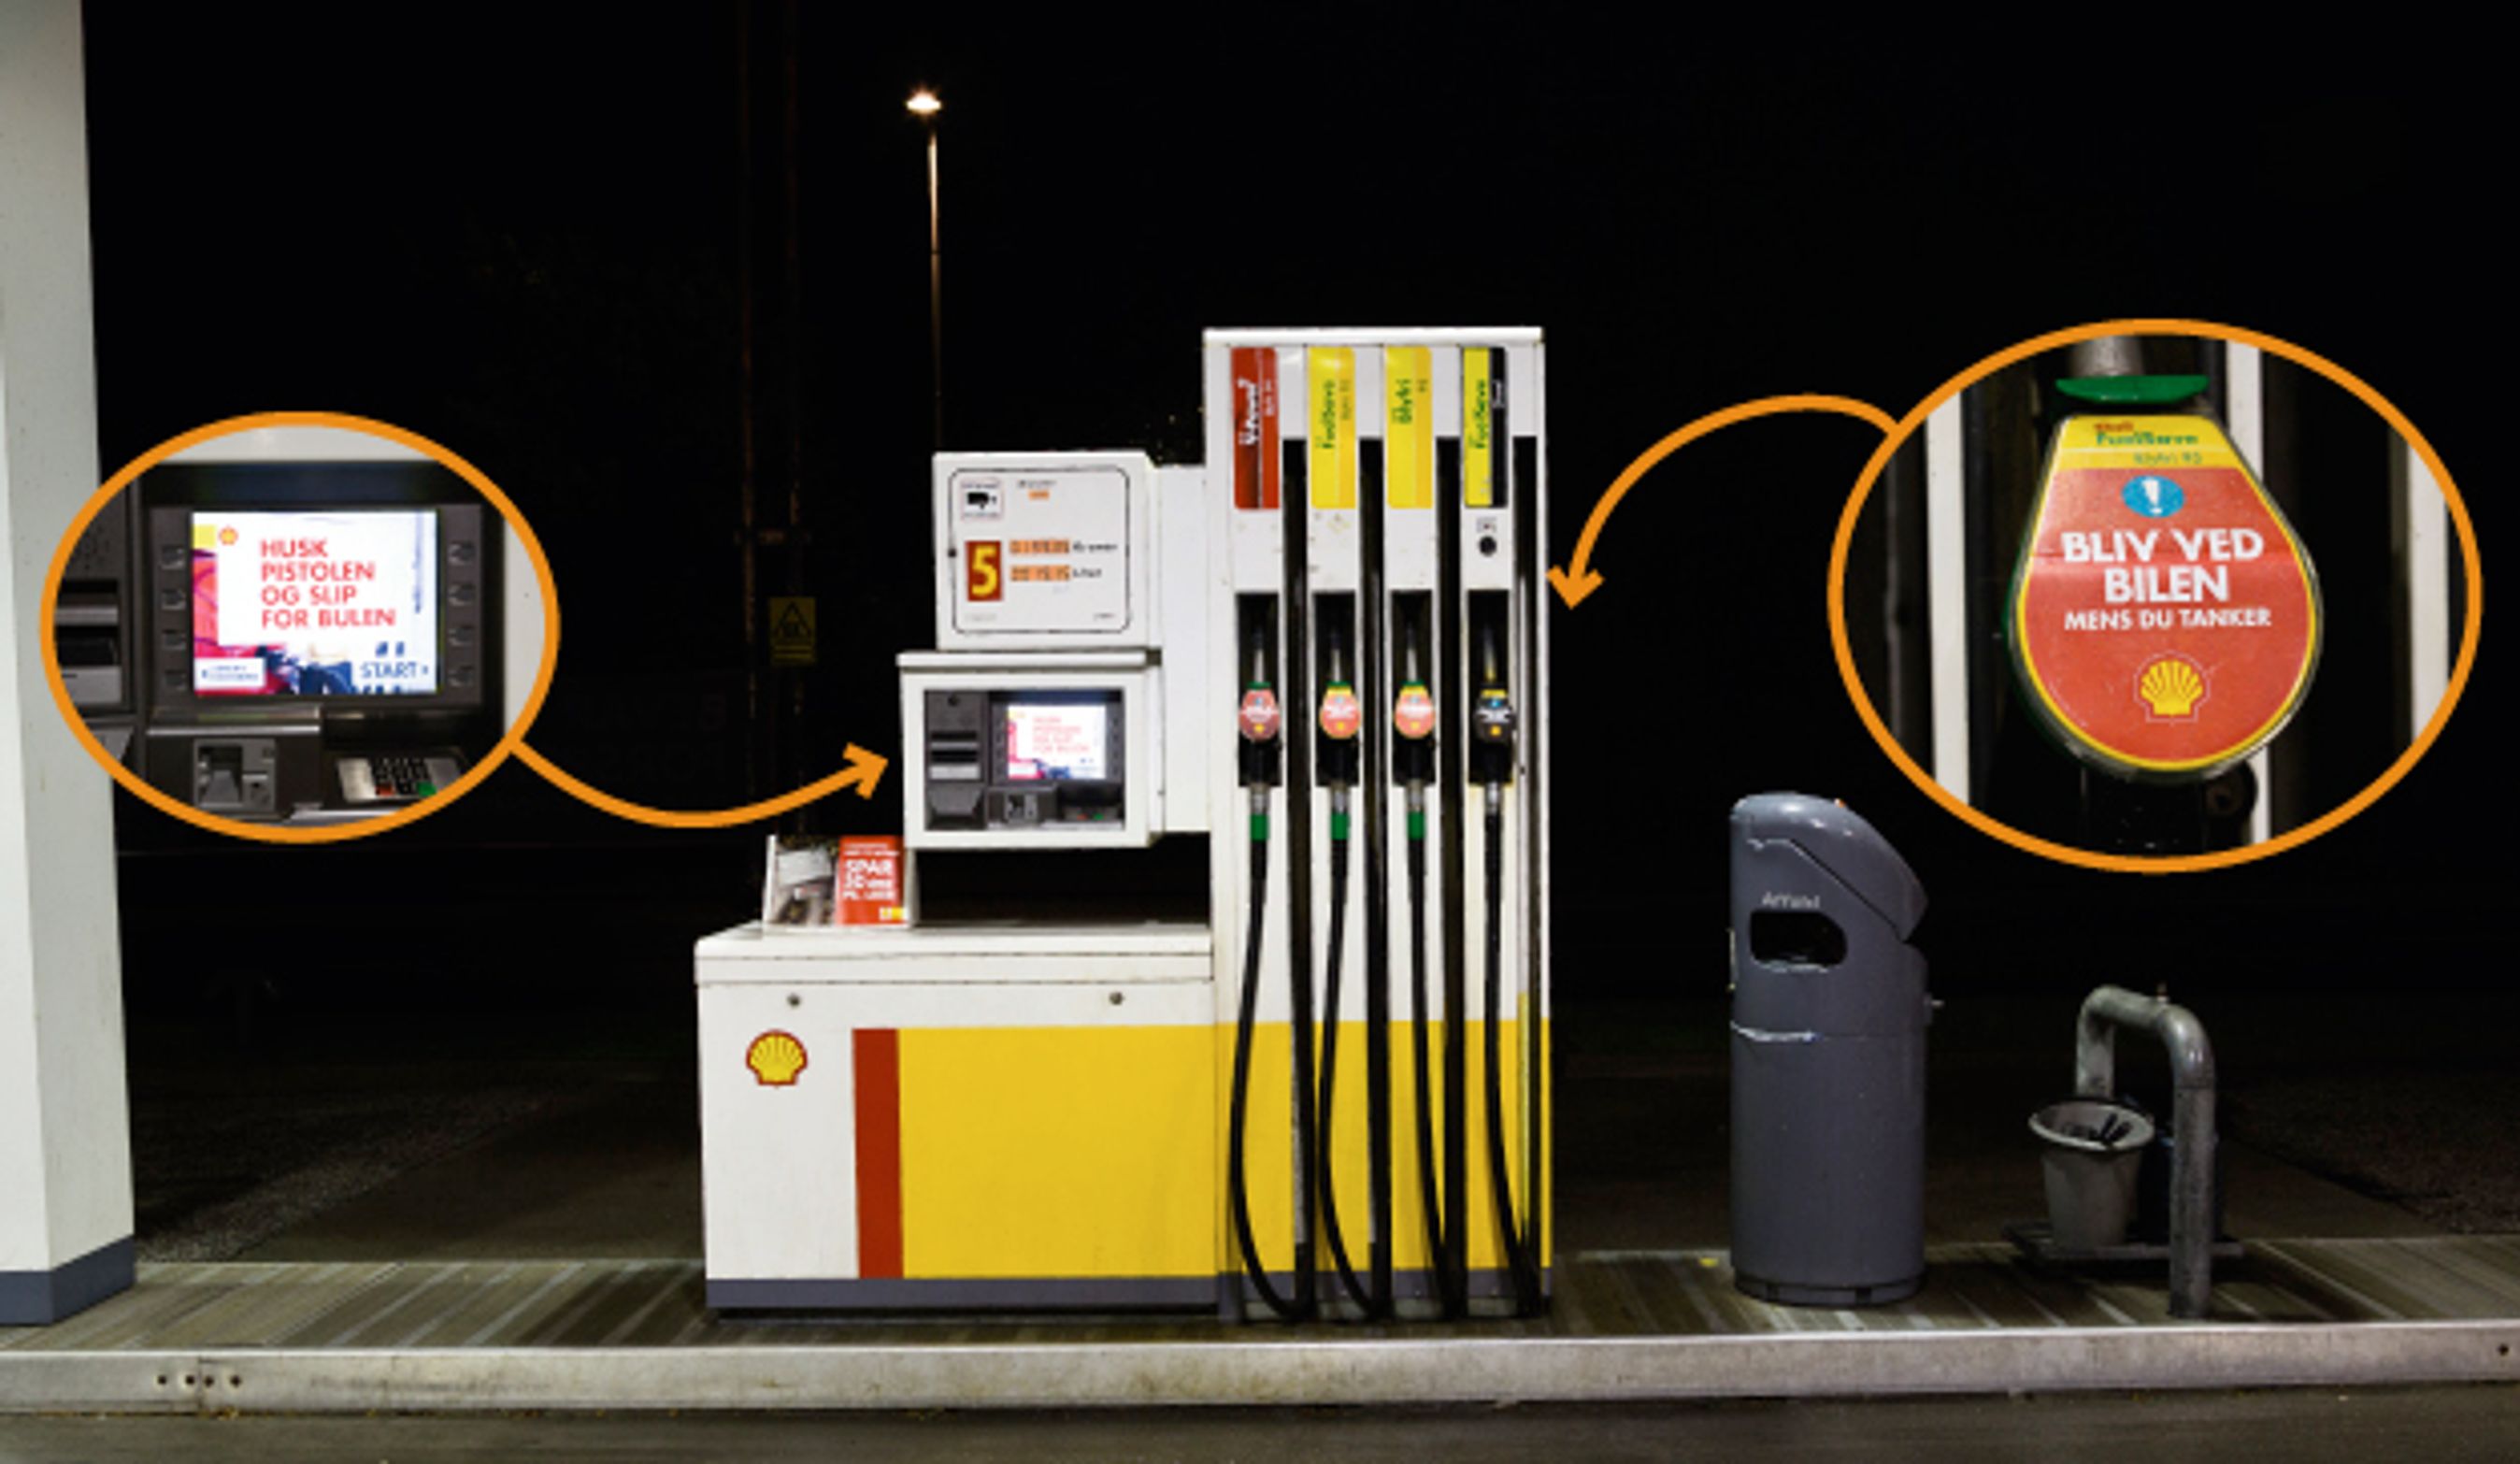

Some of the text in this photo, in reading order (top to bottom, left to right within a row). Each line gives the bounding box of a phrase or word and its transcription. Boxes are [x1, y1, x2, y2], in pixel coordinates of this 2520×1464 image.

[260, 539, 329, 558] HUSK
[2062, 528, 2264, 562] BLIV VED
[261, 562, 376, 581] PISTOLEN
[971, 545, 998, 596] 5
[2104, 566, 2229, 603] BILEN
[261, 585, 357, 606] OG SLIP
[262, 609, 396, 629] FOR BULEN
[2065, 608, 2271, 630] MENS DU TANKER
[360, 662, 417, 679] START
